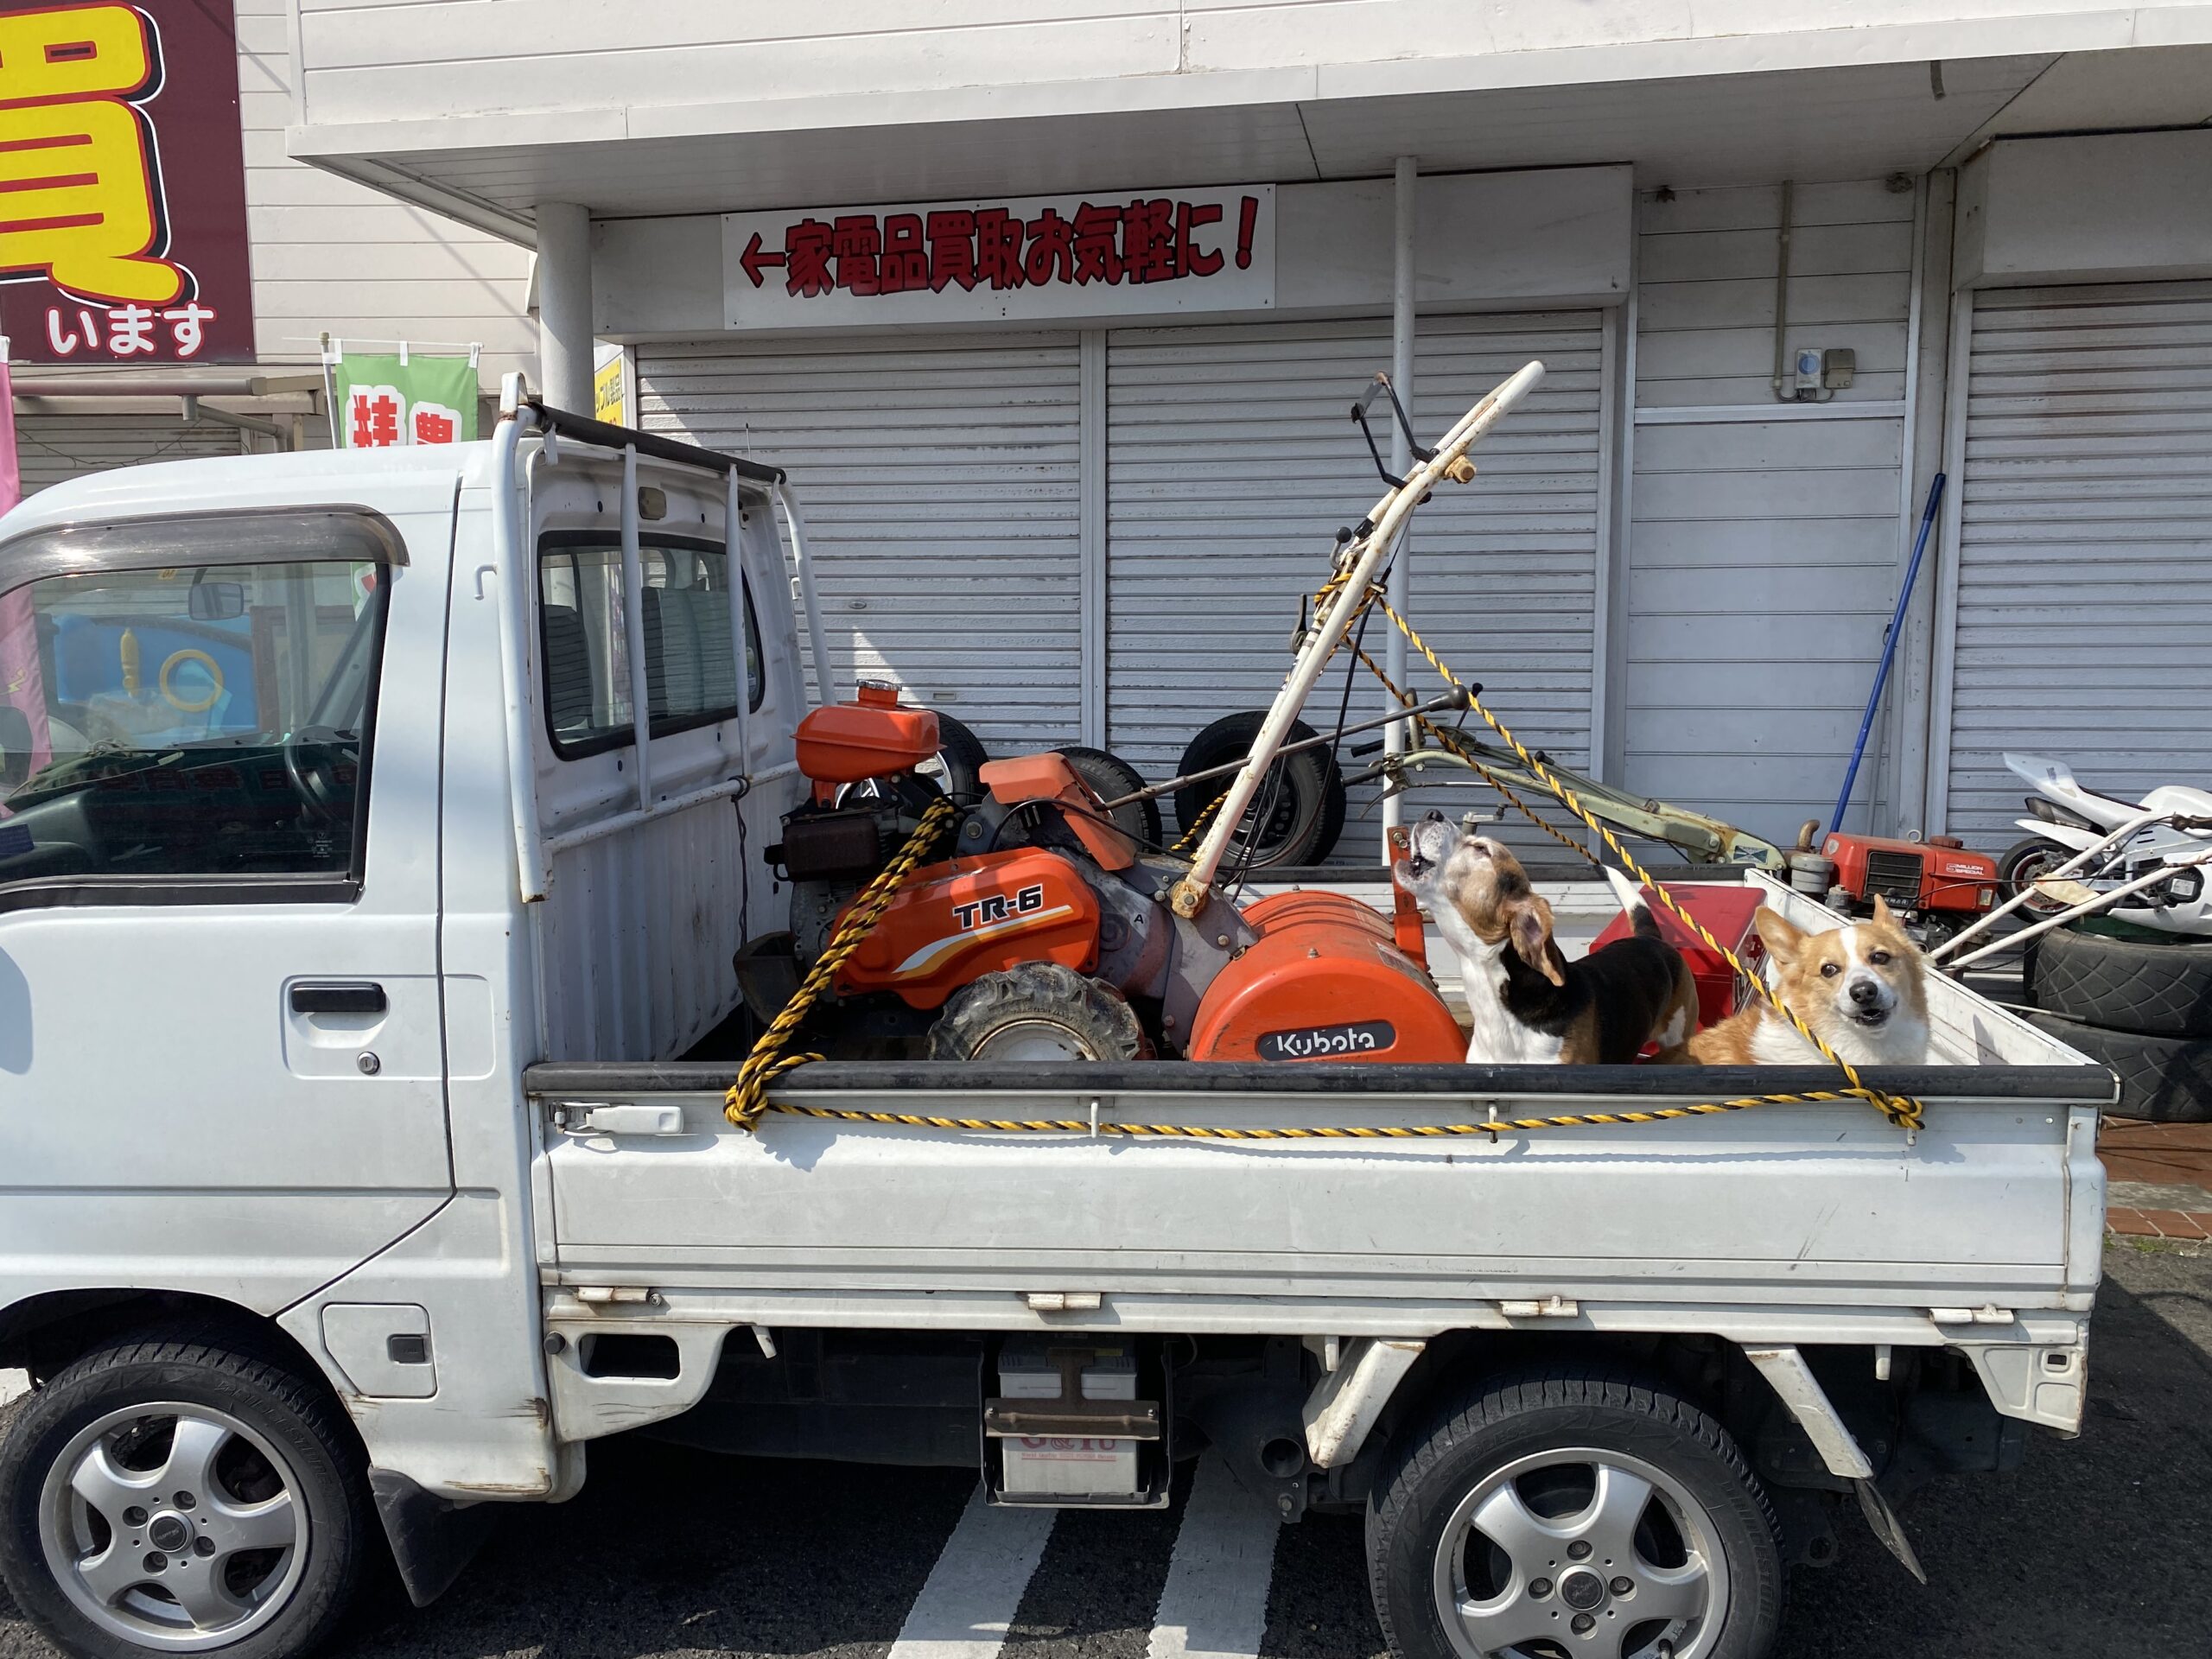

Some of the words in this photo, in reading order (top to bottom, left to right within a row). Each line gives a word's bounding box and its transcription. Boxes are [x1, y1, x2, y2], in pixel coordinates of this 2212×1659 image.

[785, 196, 1259, 297] 家電品買取お気軽に！
[46, 301, 217, 358] います
[952, 883, 1043, 930] TR-6
[1134, 913, 1145, 925] A
[1276, 1027, 1376, 1056] Kubota
